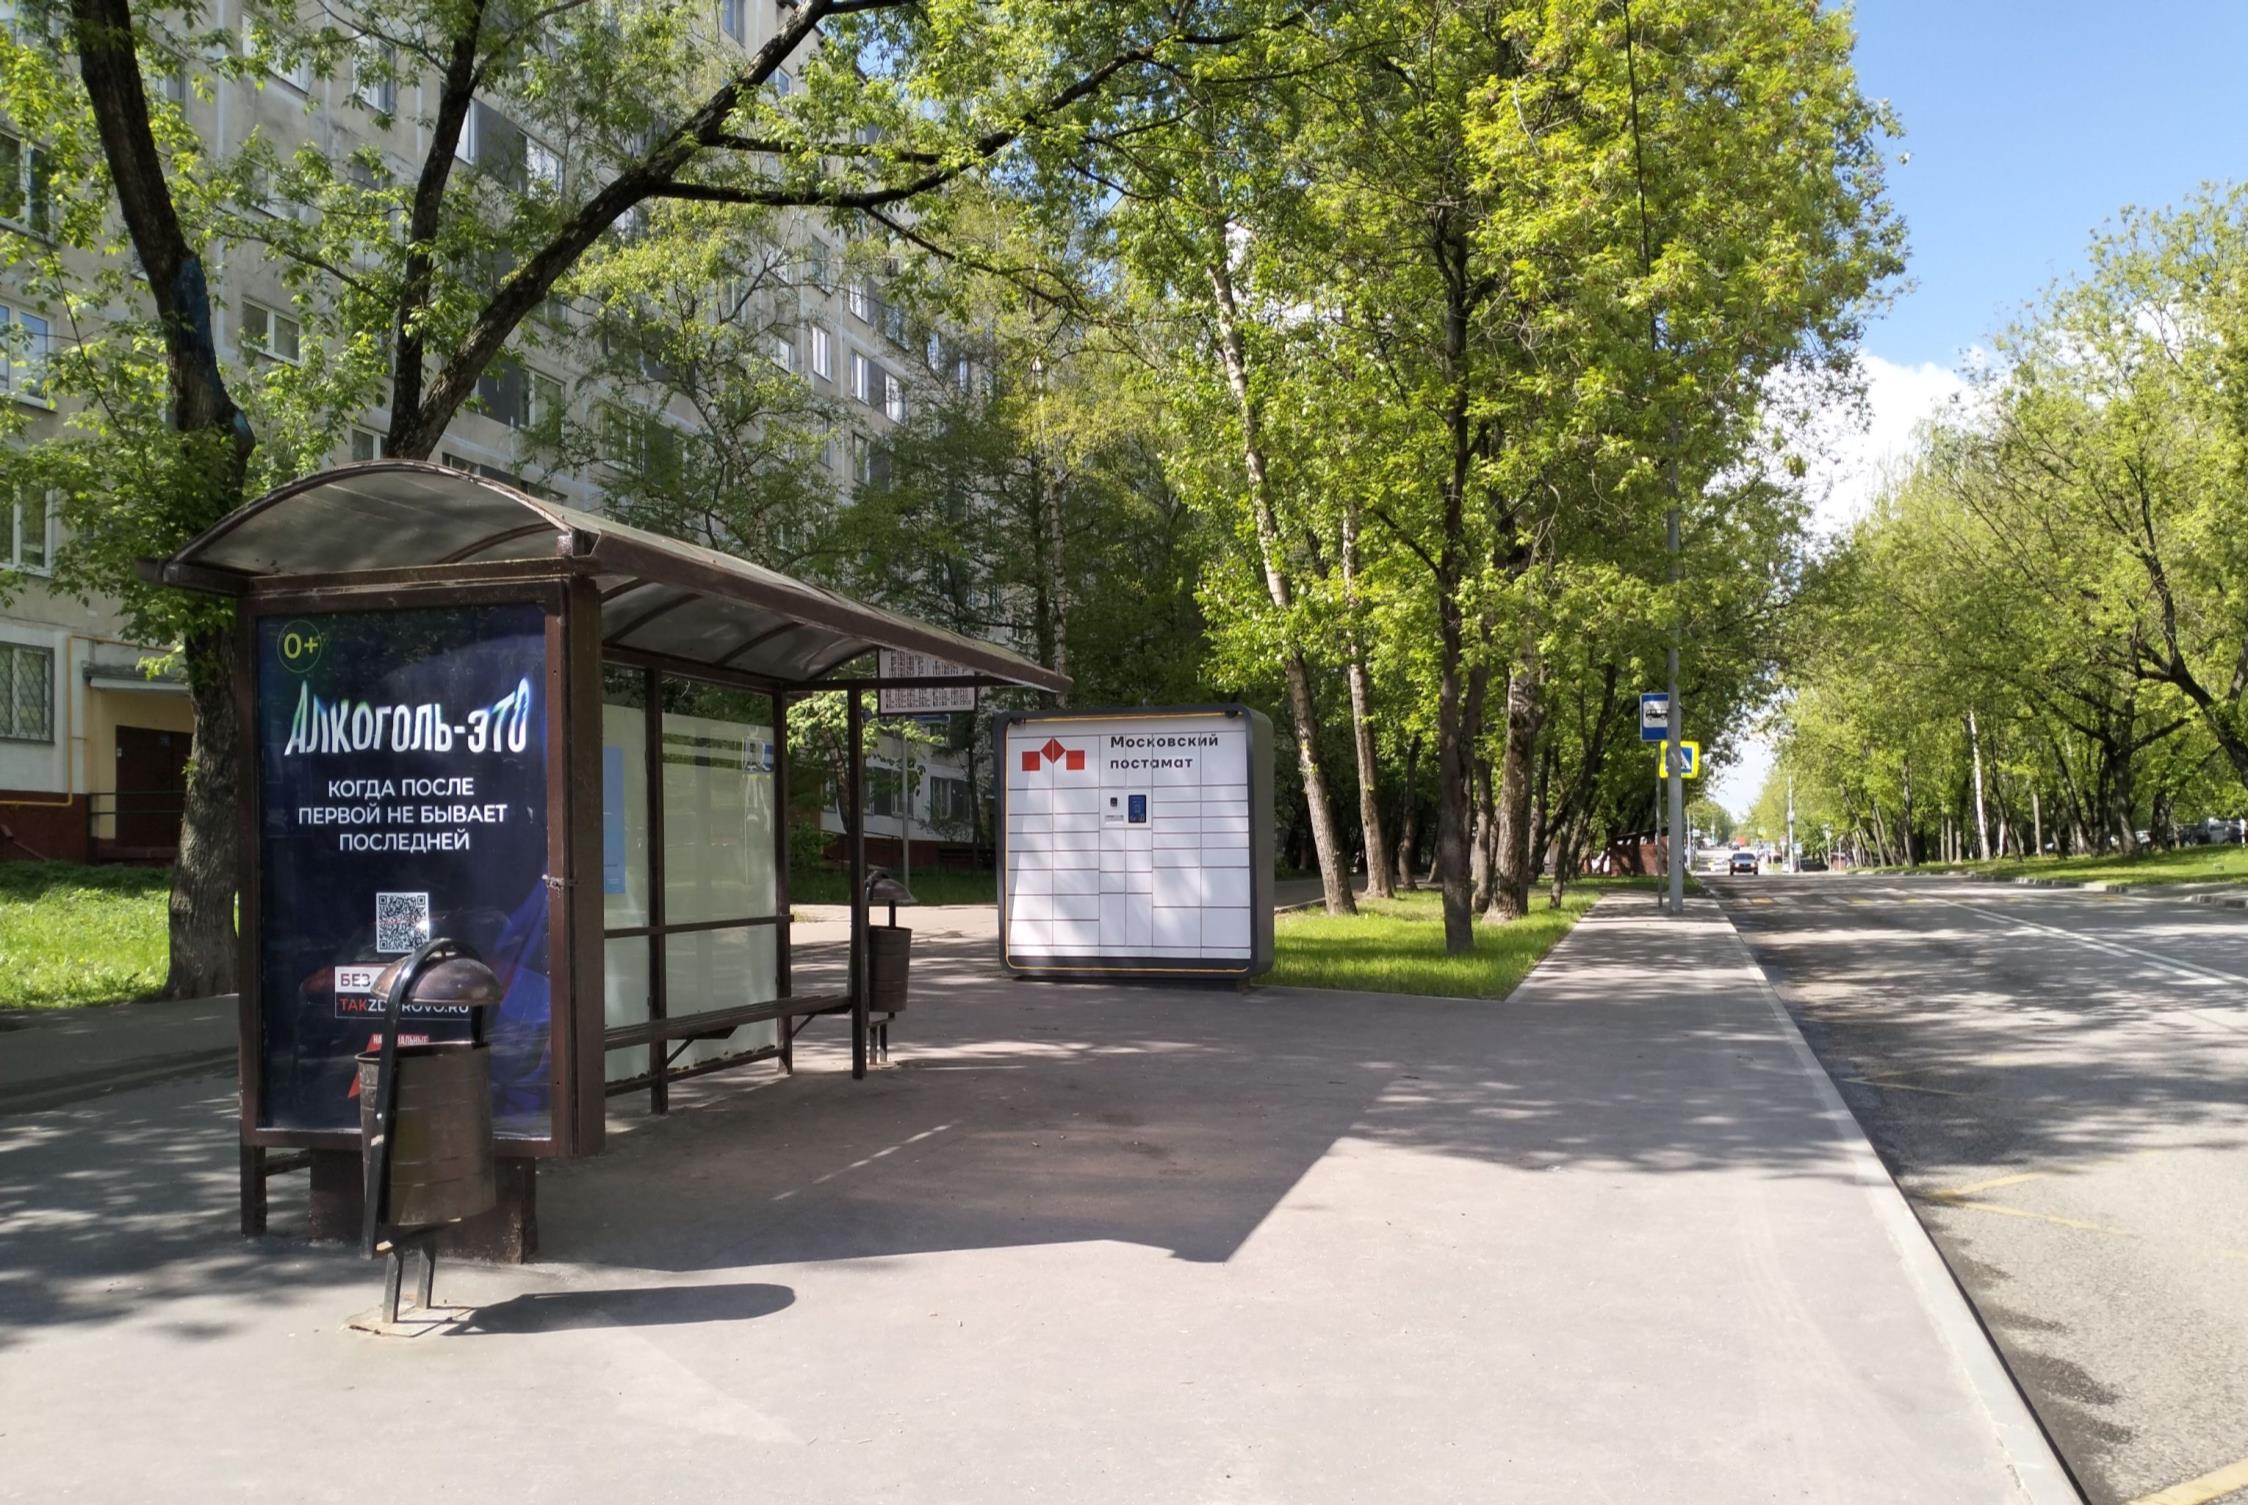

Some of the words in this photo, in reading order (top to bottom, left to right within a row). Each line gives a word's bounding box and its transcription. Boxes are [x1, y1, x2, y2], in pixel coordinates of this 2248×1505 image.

[283, 633, 318, 659] 0+
[1110, 734, 1219, 748] Московский
[1110, 758, 1193, 770] постамат
[328, 779, 395, 800] КОГДА
[401, 778, 474, 797] ПОСЛЕ
[298, 803, 380, 824] ПЕРВОЙ
[387, 806, 414, 823] НЕ
[421, 804, 507, 823] БЫВАЕТ
[339, 829, 469, 853] ПОСЛЕДНЕЙ
[340, 973, 371, 987] БЕЗ
[340, 998, 469, 1013] TAKZDROVO.RU
